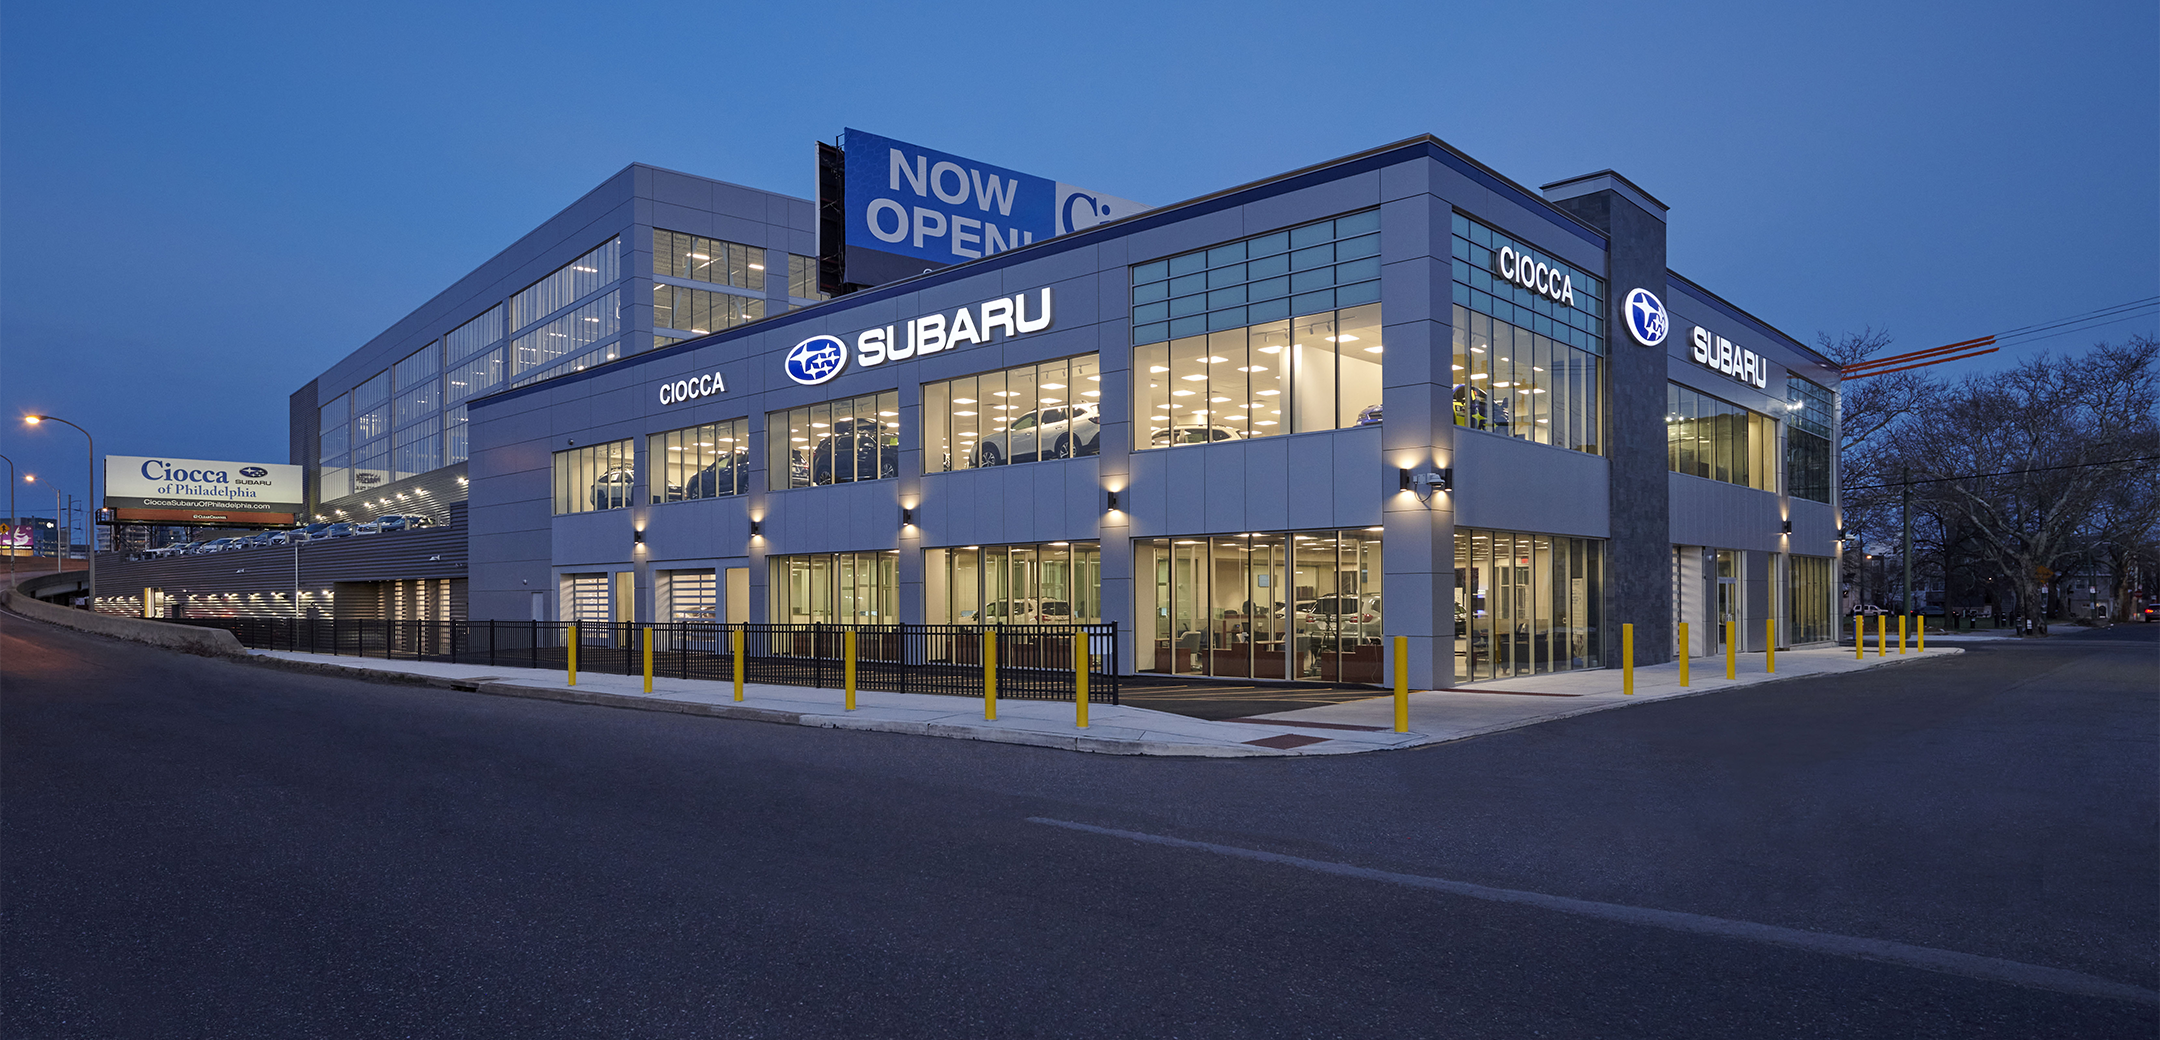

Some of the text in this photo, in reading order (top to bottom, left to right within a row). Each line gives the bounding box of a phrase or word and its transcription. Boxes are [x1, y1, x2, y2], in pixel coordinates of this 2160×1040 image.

[889, 147, 1018, 217] NOW
[1500, 245, 1574, 306] CIOCCA
[858, 287, 1051, 367] SUBARU
[1693, 325, 1767, 389] SUBARU
[659, 371, 725, 405] CIOCCA
[141, 459, 229, 484] Ciocca
[235, 478, 272, 486] SUBARU
[143, 499, 271, 510] CioccaSubaruOfPhiladelphia.com
[157, 483, 257, 500] of Philadelphia
